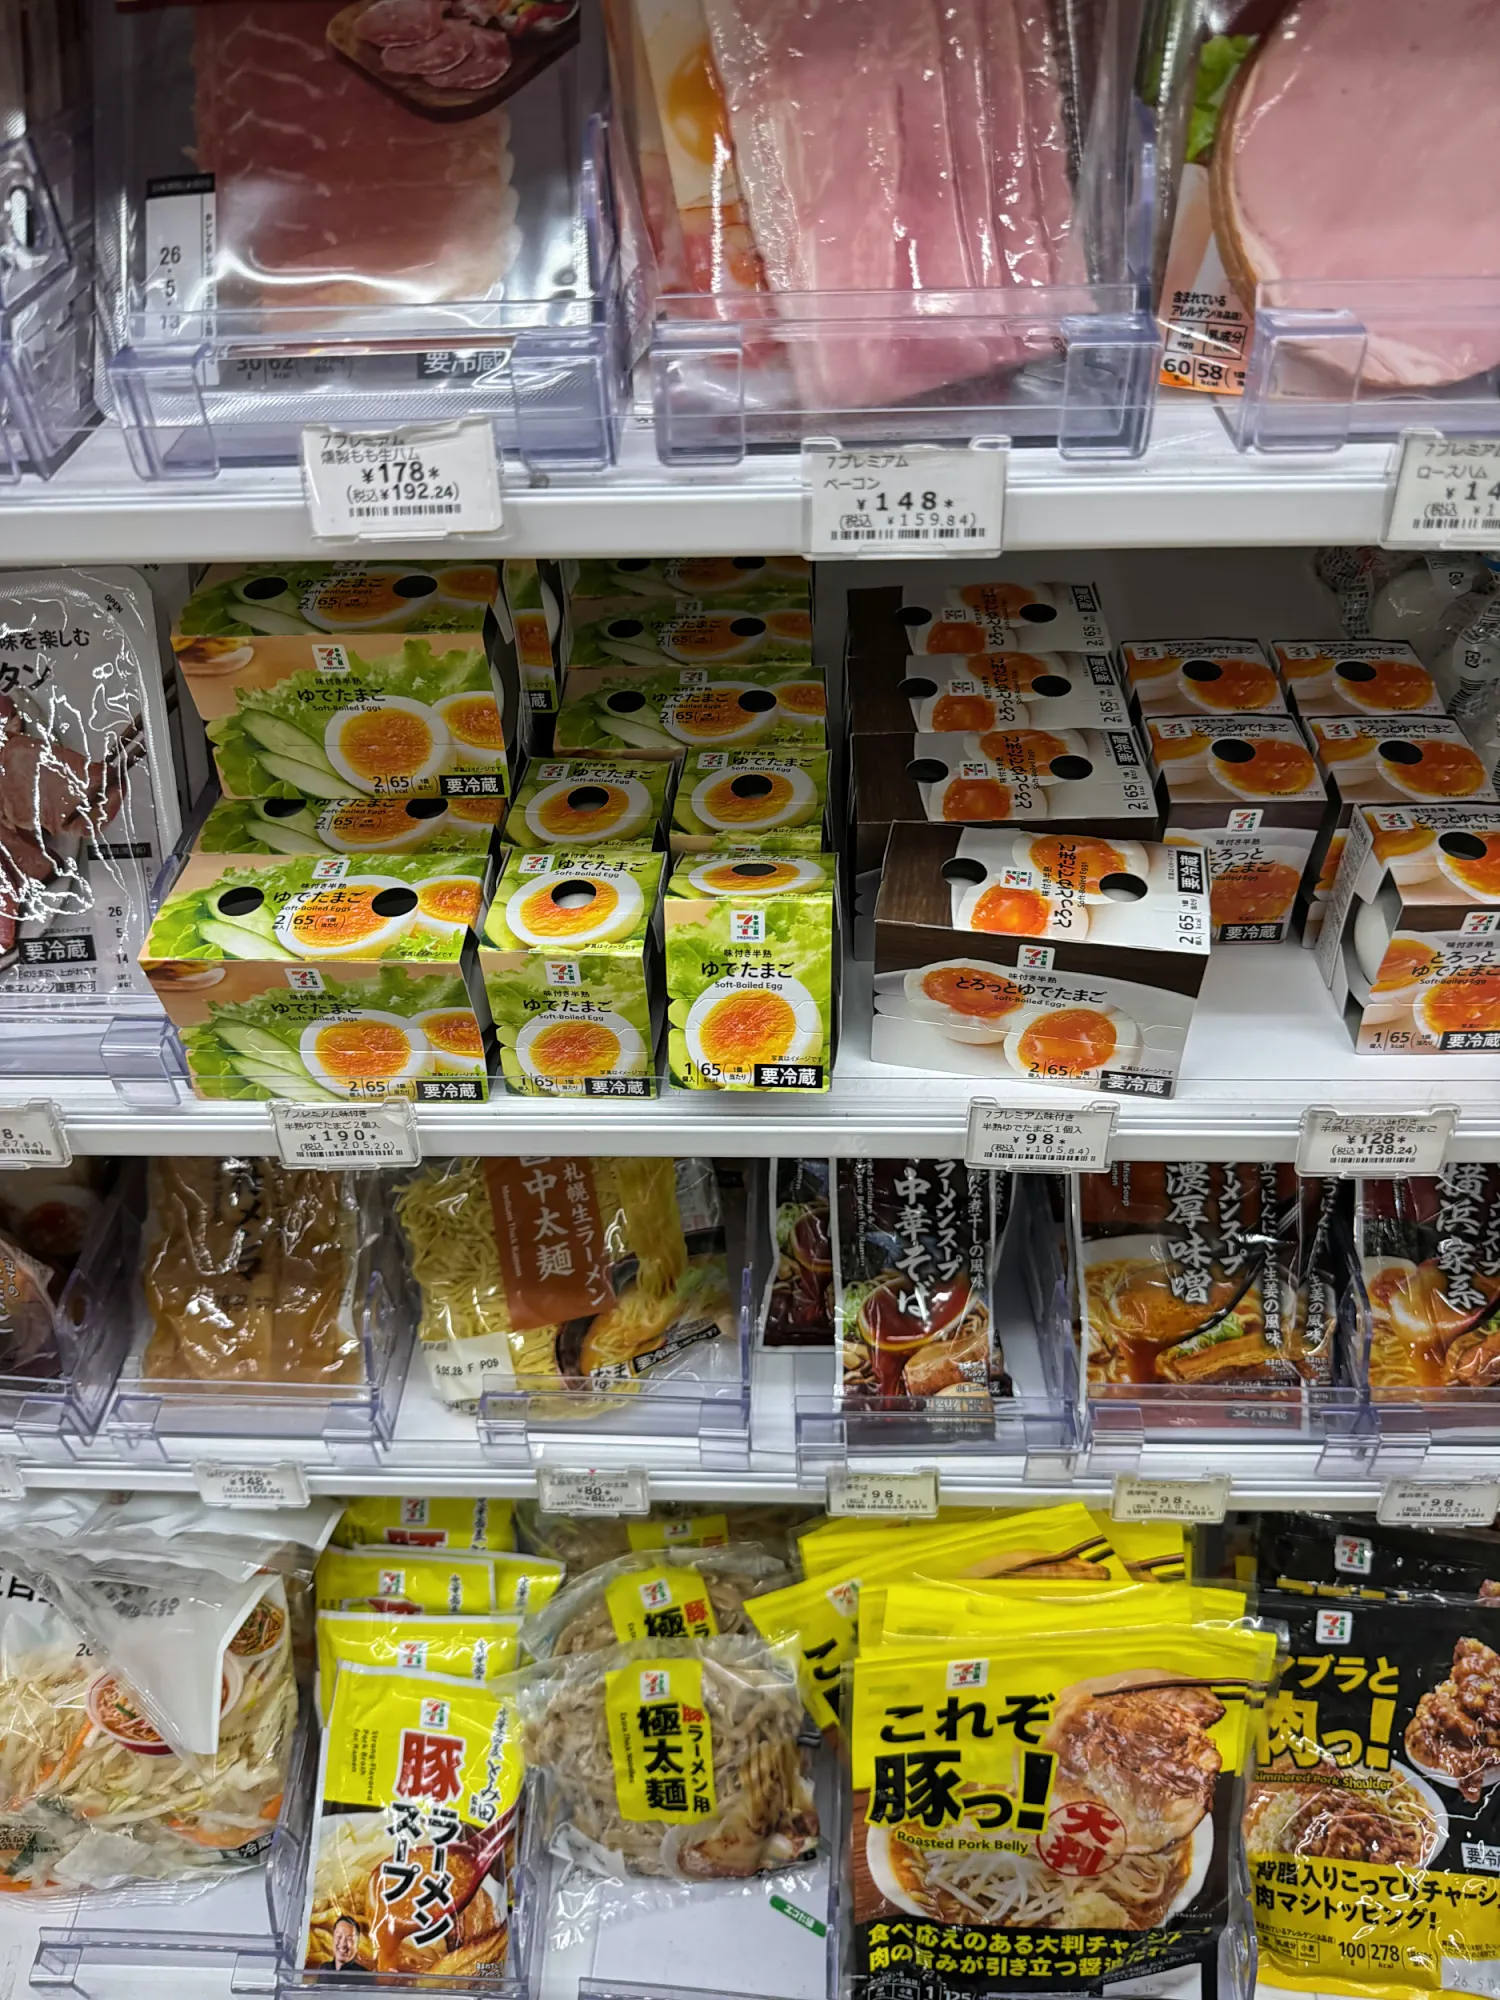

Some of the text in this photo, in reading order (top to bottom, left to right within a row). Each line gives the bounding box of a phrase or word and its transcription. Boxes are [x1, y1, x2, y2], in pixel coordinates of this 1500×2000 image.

[160, 246, 181, 265] 26
[166, 279, 175, 297] 5
[1163, 358, 1223, 380] 60 58
[826, 454, 909, 470] 7プレミアム
[1416, 464, 1488, 479] ロースハム
[823, 476, 881, 491] ベーコン
[104, 593, 124, 613] OPEN
[1089, 656, 1114, 684] 要冷蔵
[296, 687, 387, 703] ゆでたまご
[652, 692, 731, 703] ゆでたまご
[1100, 700, 1114, 713] 65
[1359, 724, 1454, 734] とろっとゆでたまご
[1111, 734, 1137, 764] 要冷蔵
[732, 756, 815, 769] ゆでたまご
[572, 768, 653, 780] ゆでたまご
[1003, 736, 1033, 810] とろっとゆでたまご
[389, 776, 410, 788] 65
[446, 776, 499, 794] 要冷蔵
[1124, 784, 1139, 798] 65
[557, 858, 648, 873] ゆでたまご
[1180, 854, 1202, 890] 要冷蔵
[554, 871, 620, 879] Soft-Boiled Egg
[1042, 865, 1053, 897] 味付き半熟
[1052, 842, 1076, 929] とろっとゆでたまご
[1077, 861, 1089, 908] Soft-Boiled Eggs
[273, 890, 368, 904] ゆでたまご
[280, 904, 331, 912] Soft-Boiled
[293, 914, 316, 925] 65
[1178, 914, 1194, 930] 65
[108, 906, 122, 917] 26
[116, 954, 129, 964] 14
[1225, 925, 1277, 941] 要冷蔵
[24, 939, 89, 961] 要冷蔵
[1446, 941, 1494, 949] 味付き半熟
[723, 949, 773, 958] 味付き半熟
[1430, 950, 1497, 964] とろっと
[701, 961, 795, 980] ゆでたまご
[1008, 973, 1057, 984] 味付き半熟
[714, 981, 783, 991] Soft-Boiled Egg
[955, 976, 1107, 1004] とろっとゆでたまご
[270, 1002, 363, 1015] ゆでたまご
[523, 998, 613, 1014] ゆでたまご
[993, 994, 1067, 1008] Soft-Boiled Eggs
[538, 1013, 587, 1021] Soft-Boiled
[1389, 1031, 1411, 1043] 65
[771, 1055, 824, 1063] 写真はイメージです
[700, 1062, 721, 1075] 65
[760, 1066, 817, 1086] 要冷蔵
[1029, 1062, 1069, 1076] 2 65
[365, 1081, 386, 1092] 65
[423, 1083, 478, 1099] 要冷蔵
[591, 1079, 645, 1095] 要冷蔵
[1107, 1073, 1165, 1094] 要冷蔵
[985, 1110, 1075, 1122] 7プレミアム味付き
[981, 1122, 1083, 1134] 半熟ゆでたまご1個入
[1122, 1186, 1131, 1208] Soup
[521, 1168, 576, 1282] 中太麺
[563, 1161, 606, 1307] 札幌生ラーメン
[1165, 1162, 1213, 1305] 濃厚味噌
[1436, 1163, 1491, 1311] 横浜家系
[894, 1166, 933, 1320] 中華そば
[880, 1693, 1058, 1744] これぞ
[1255, 1690, 1397, 1771] 肉っ!
[637, 1702, 689, 1812] 極太麺
[396, 1731, 464, 1803] 豚
[1313, 1773, 1341, 1786] Pork
[1341, 1774, 1394, 1791] Shoulder
[867, 1749, 1056, 1833] 豚っ!
[897, 1830, 1029, 1855] Roasted Pork Belly
[384, 1802, 422, 1903] スープ
[1466, 1845, 1500, 1867] 要冷
[1256, 1860, 1500, 1908] 背脂入りこってりチャーシ
[1339, 1941, 1366, 1959] 100
[1371, 1943, 1400, 1962] 278
